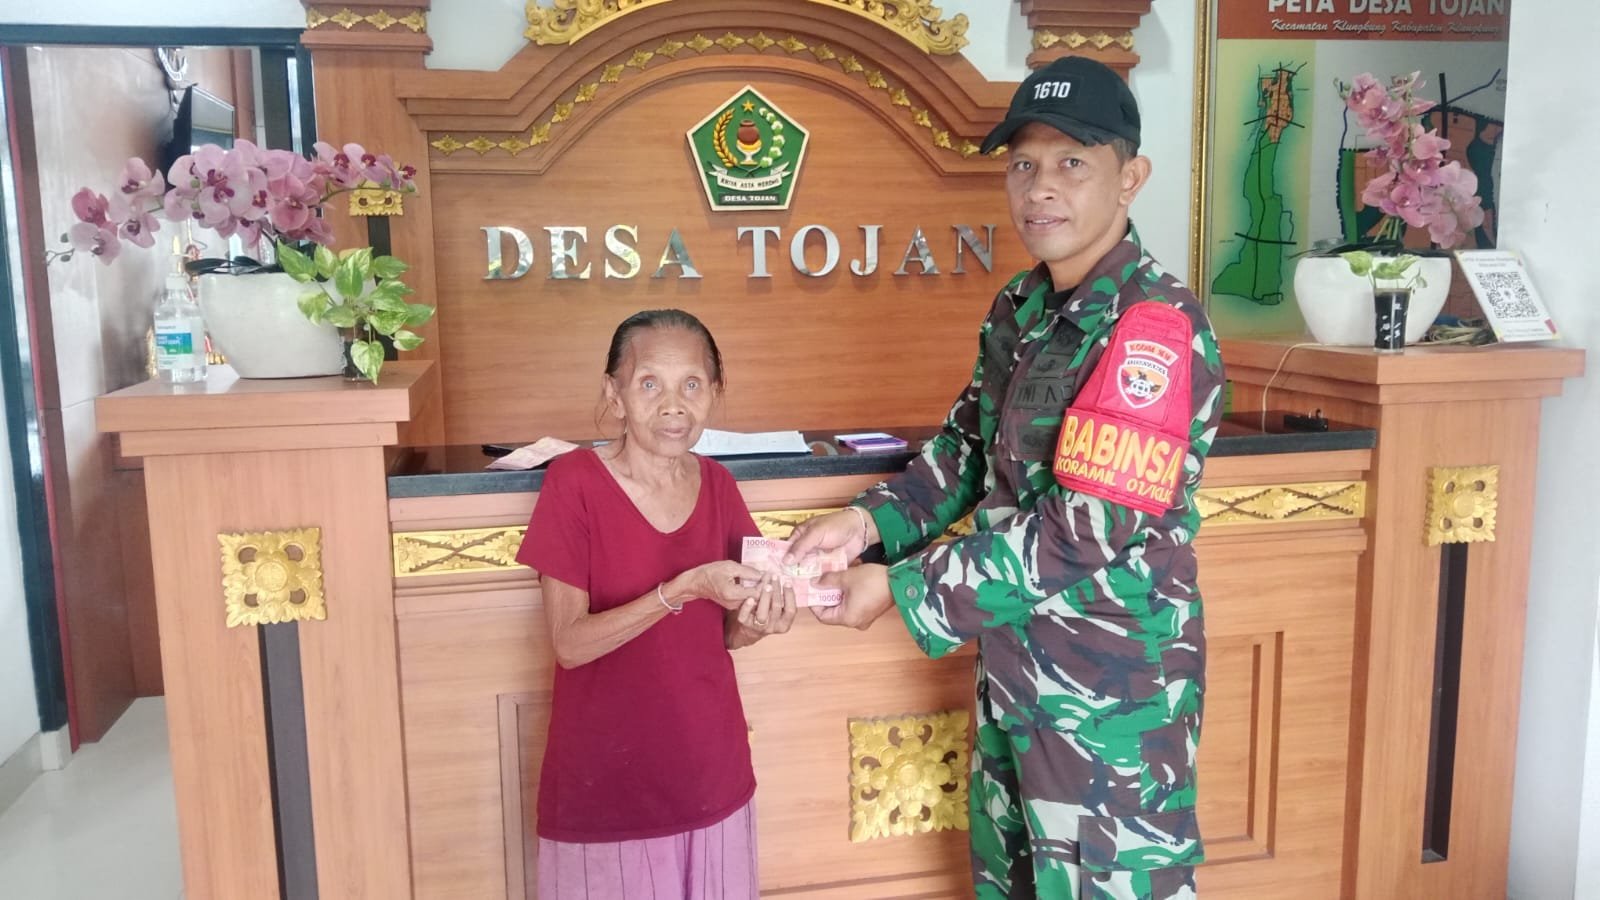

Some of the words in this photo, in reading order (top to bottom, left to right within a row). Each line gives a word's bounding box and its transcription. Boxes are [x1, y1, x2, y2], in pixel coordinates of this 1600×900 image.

[1268, 0, 1335, 13] PETA
[1349, 0, 1412, 14] DESA
[1427, 0, 1504, 18] TOJAN
[1271, 19, 1328, 31] Kecamatan
[1332, 19, 1386, 34] Klungkung
[1391, 20, 1442, 35] Kabupaten
[1034, 81, 1071, 100] 1610
[480, 224, 703, 280] DESA
[737, 224, 997, 278] TOJAN
[1061, 415, 1183, 488] BABINSA
[1056, 457, 1116, 486] KORAMIL
